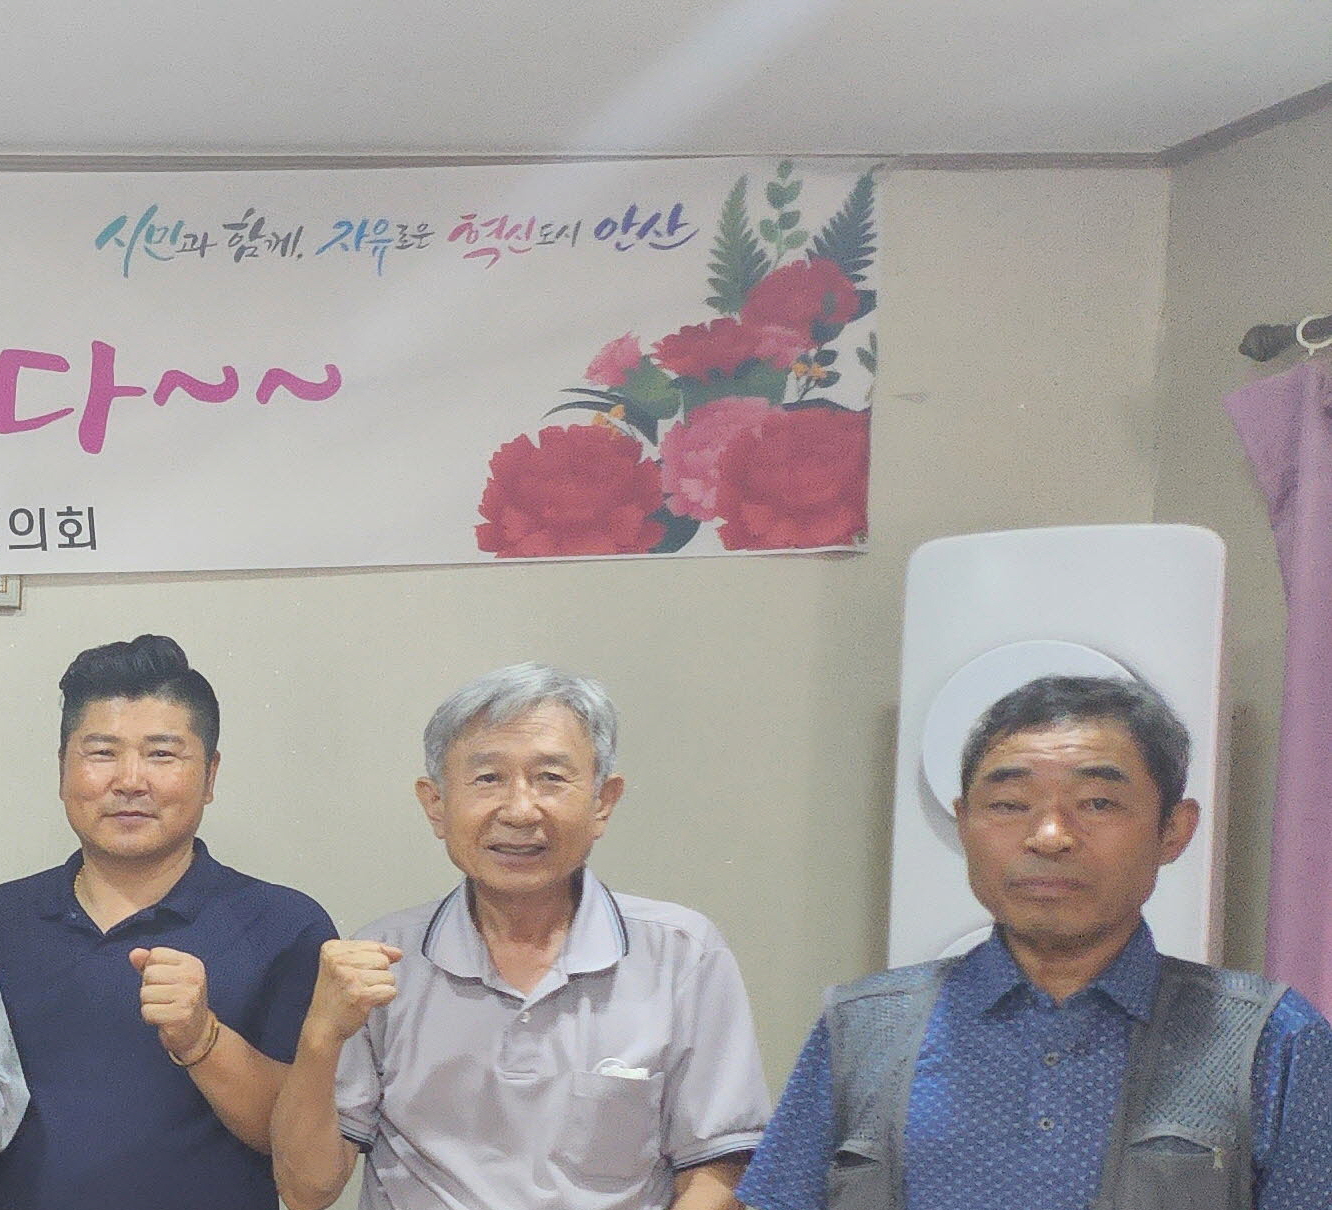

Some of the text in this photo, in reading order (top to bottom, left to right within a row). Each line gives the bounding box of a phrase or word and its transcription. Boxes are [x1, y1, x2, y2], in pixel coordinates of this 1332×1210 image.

[95, 203, 217, 278] 시민과
[315, 217, 435, 277] 자유로운
[447, 213, 583, 269] 혁신도시
[594, 202, 699, 251] 안산
